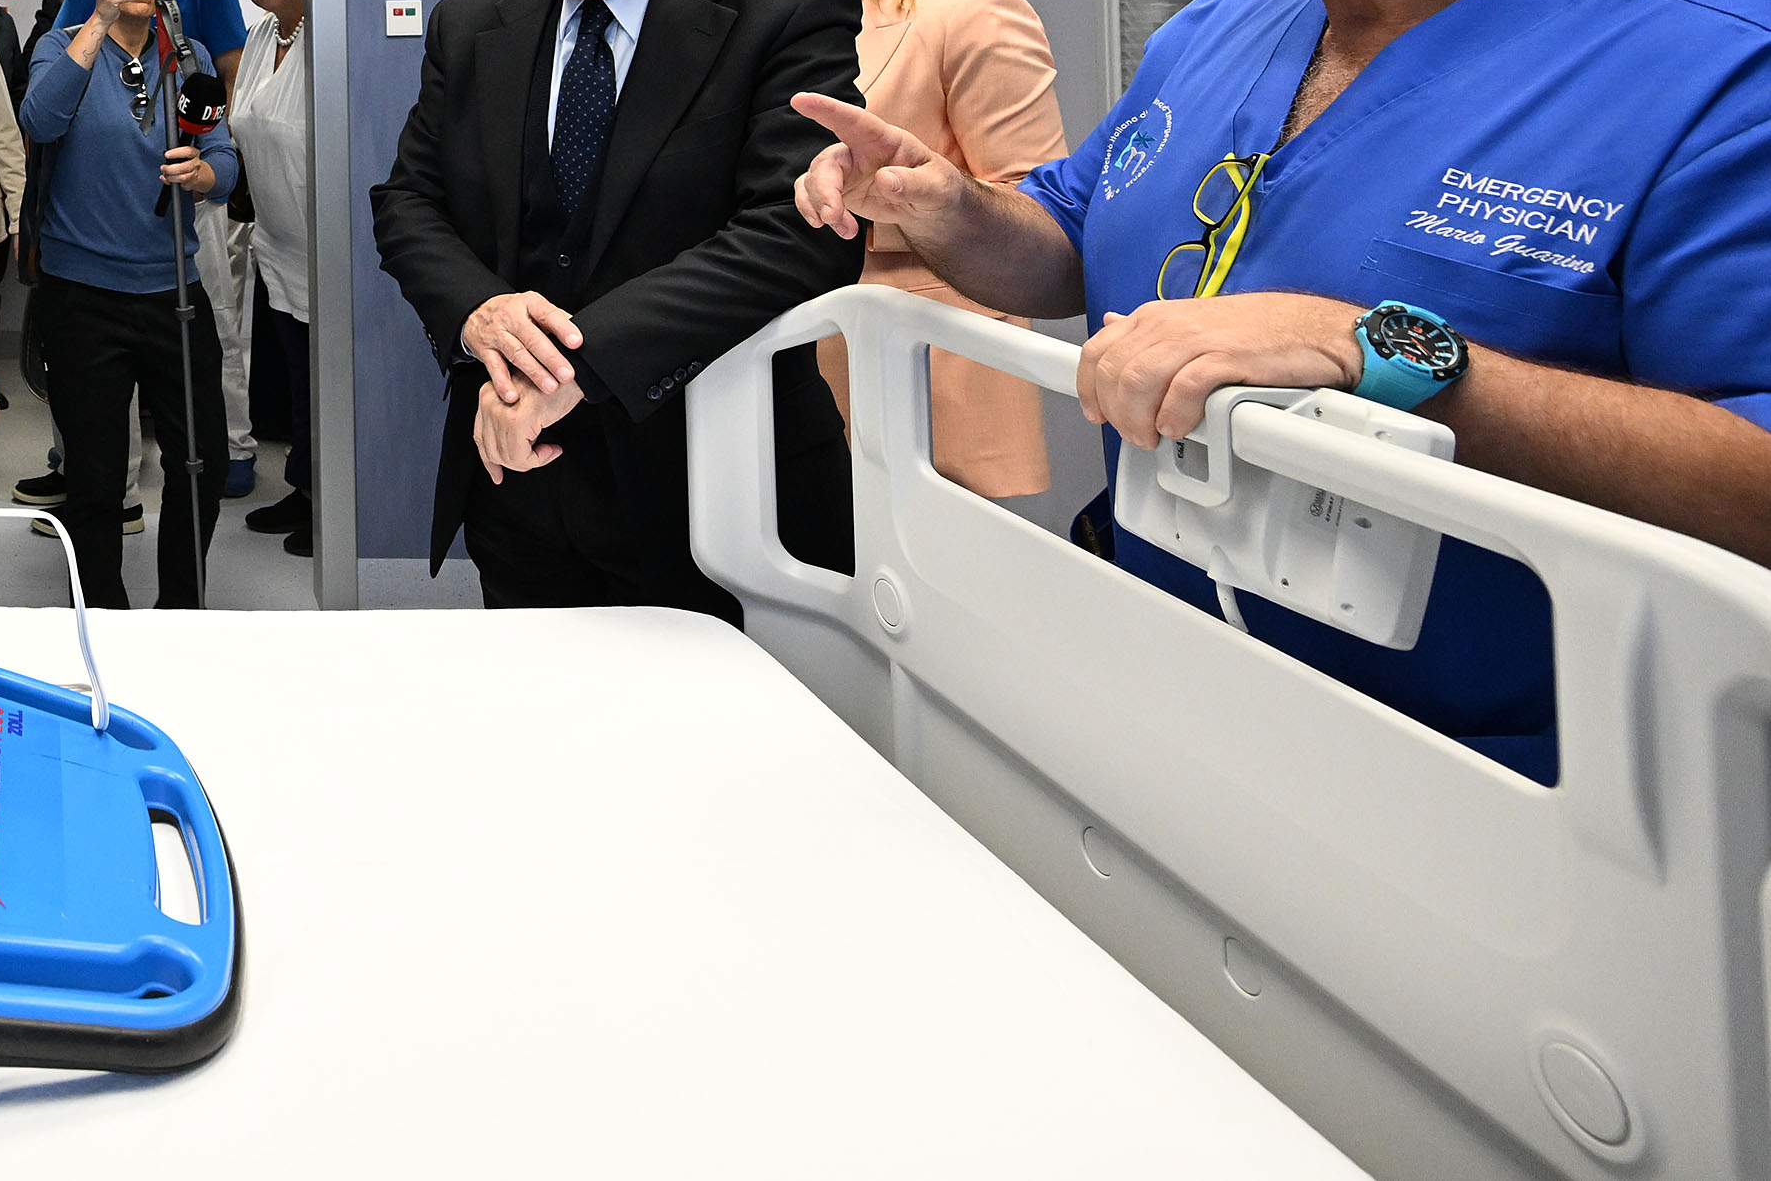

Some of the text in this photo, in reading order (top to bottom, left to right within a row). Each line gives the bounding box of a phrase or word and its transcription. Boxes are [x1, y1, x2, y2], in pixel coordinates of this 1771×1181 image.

[1437, 192, 1598, 245] PHYSICIAN
[1442, 168, 1624, 222] EMERGENCY
[1405, 210, 1596, 274] Mario Guarino
[8, 709, 24, 737] ZOLL
